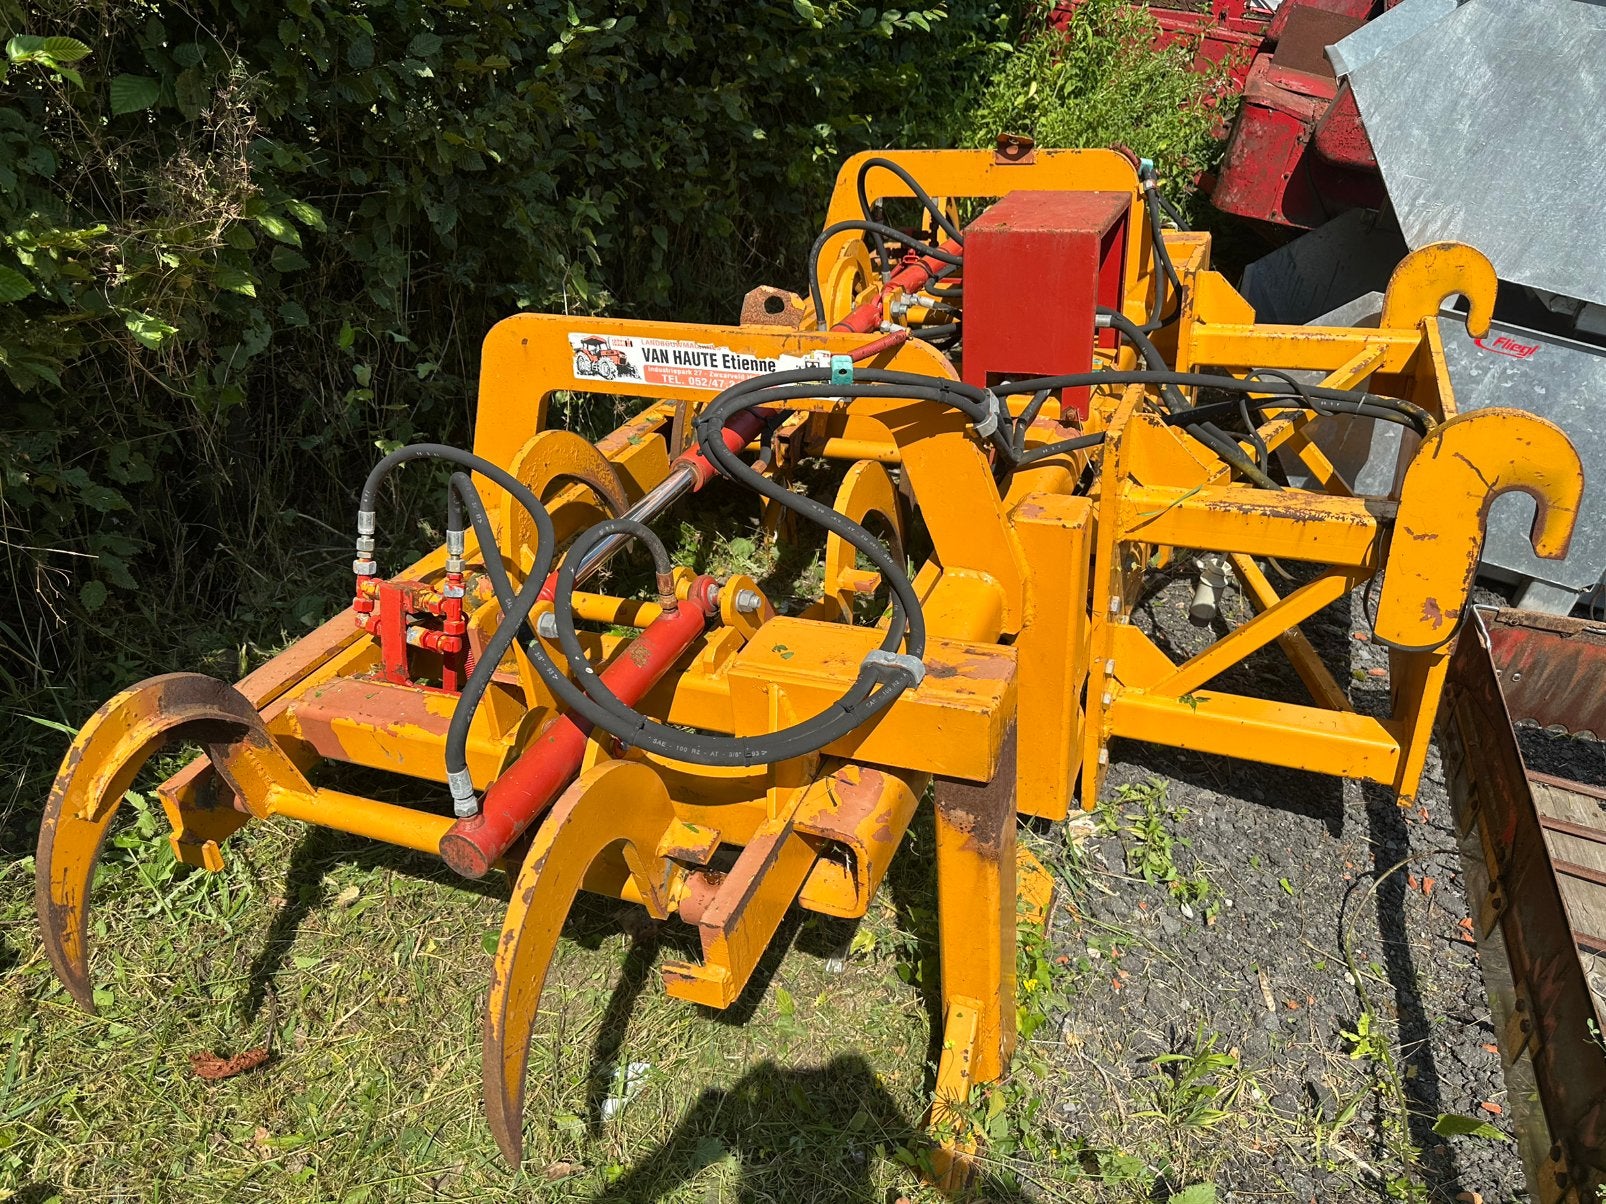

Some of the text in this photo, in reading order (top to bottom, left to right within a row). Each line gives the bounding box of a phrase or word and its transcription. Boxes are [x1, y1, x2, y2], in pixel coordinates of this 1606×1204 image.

[1492, 337, 1541, 357] Fliegl
[642, 347, 776, 373] VAN HAUTE Etienne
[661, 374, 685, 385] TEL.
[652, 738, 667, 748] SAE
[675, 745, 688, 753] 100
